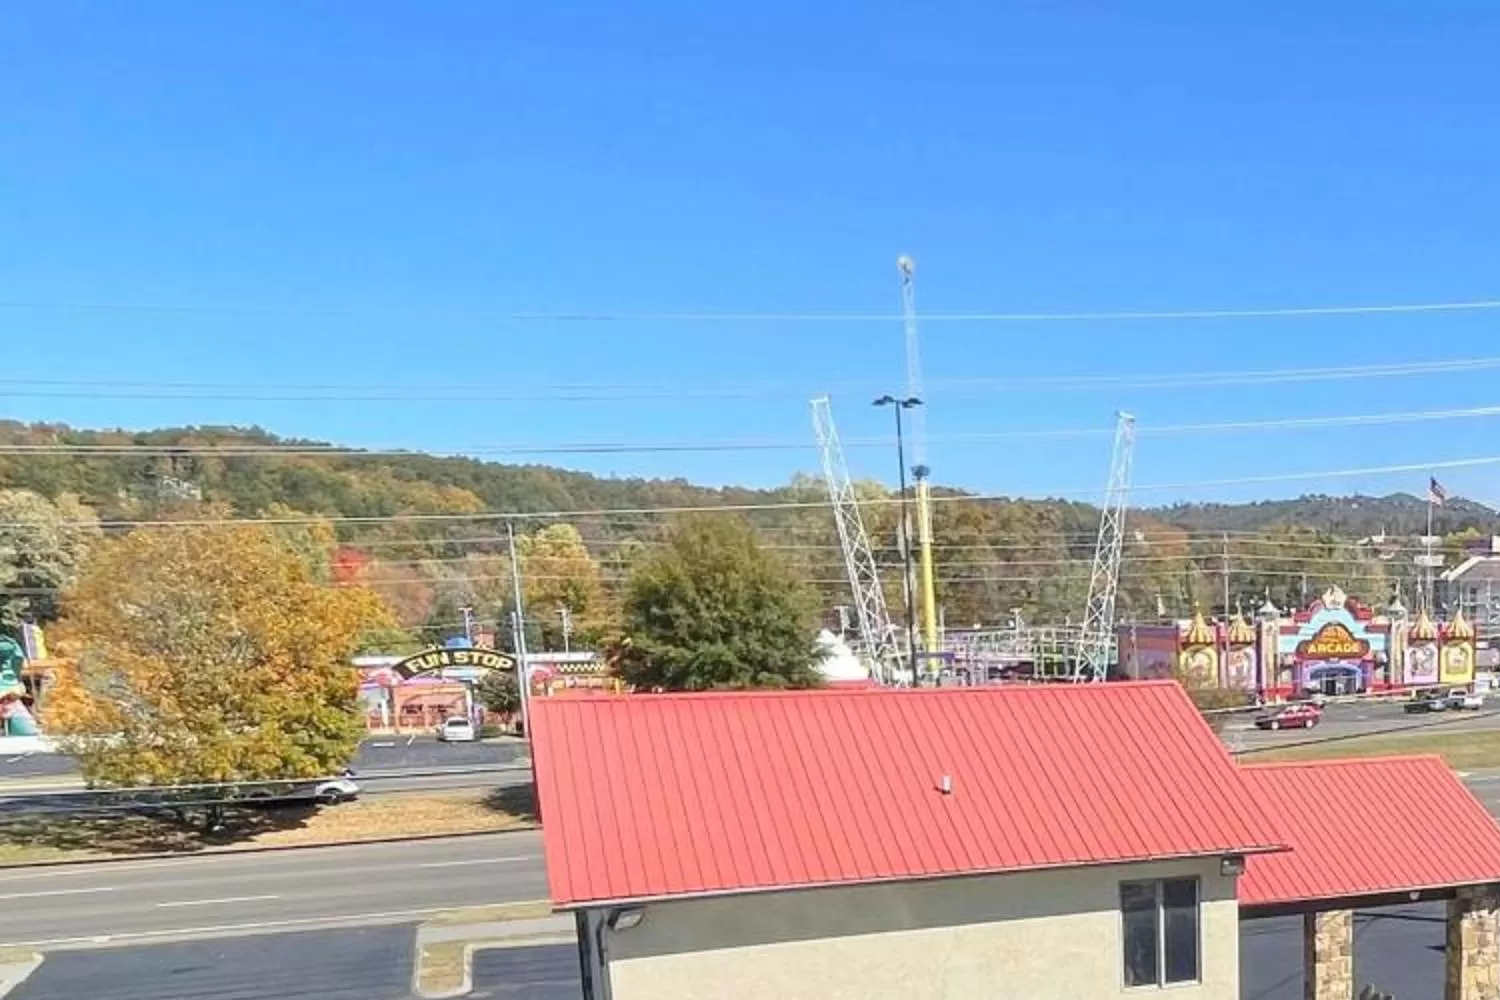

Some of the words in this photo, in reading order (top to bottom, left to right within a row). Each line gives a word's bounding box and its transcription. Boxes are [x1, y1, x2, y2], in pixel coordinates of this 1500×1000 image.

[1307, 643, 1361, 655] ARCADE
[406, 650, 449, 673] FUN
[453, 650, 514, 669] STOP
